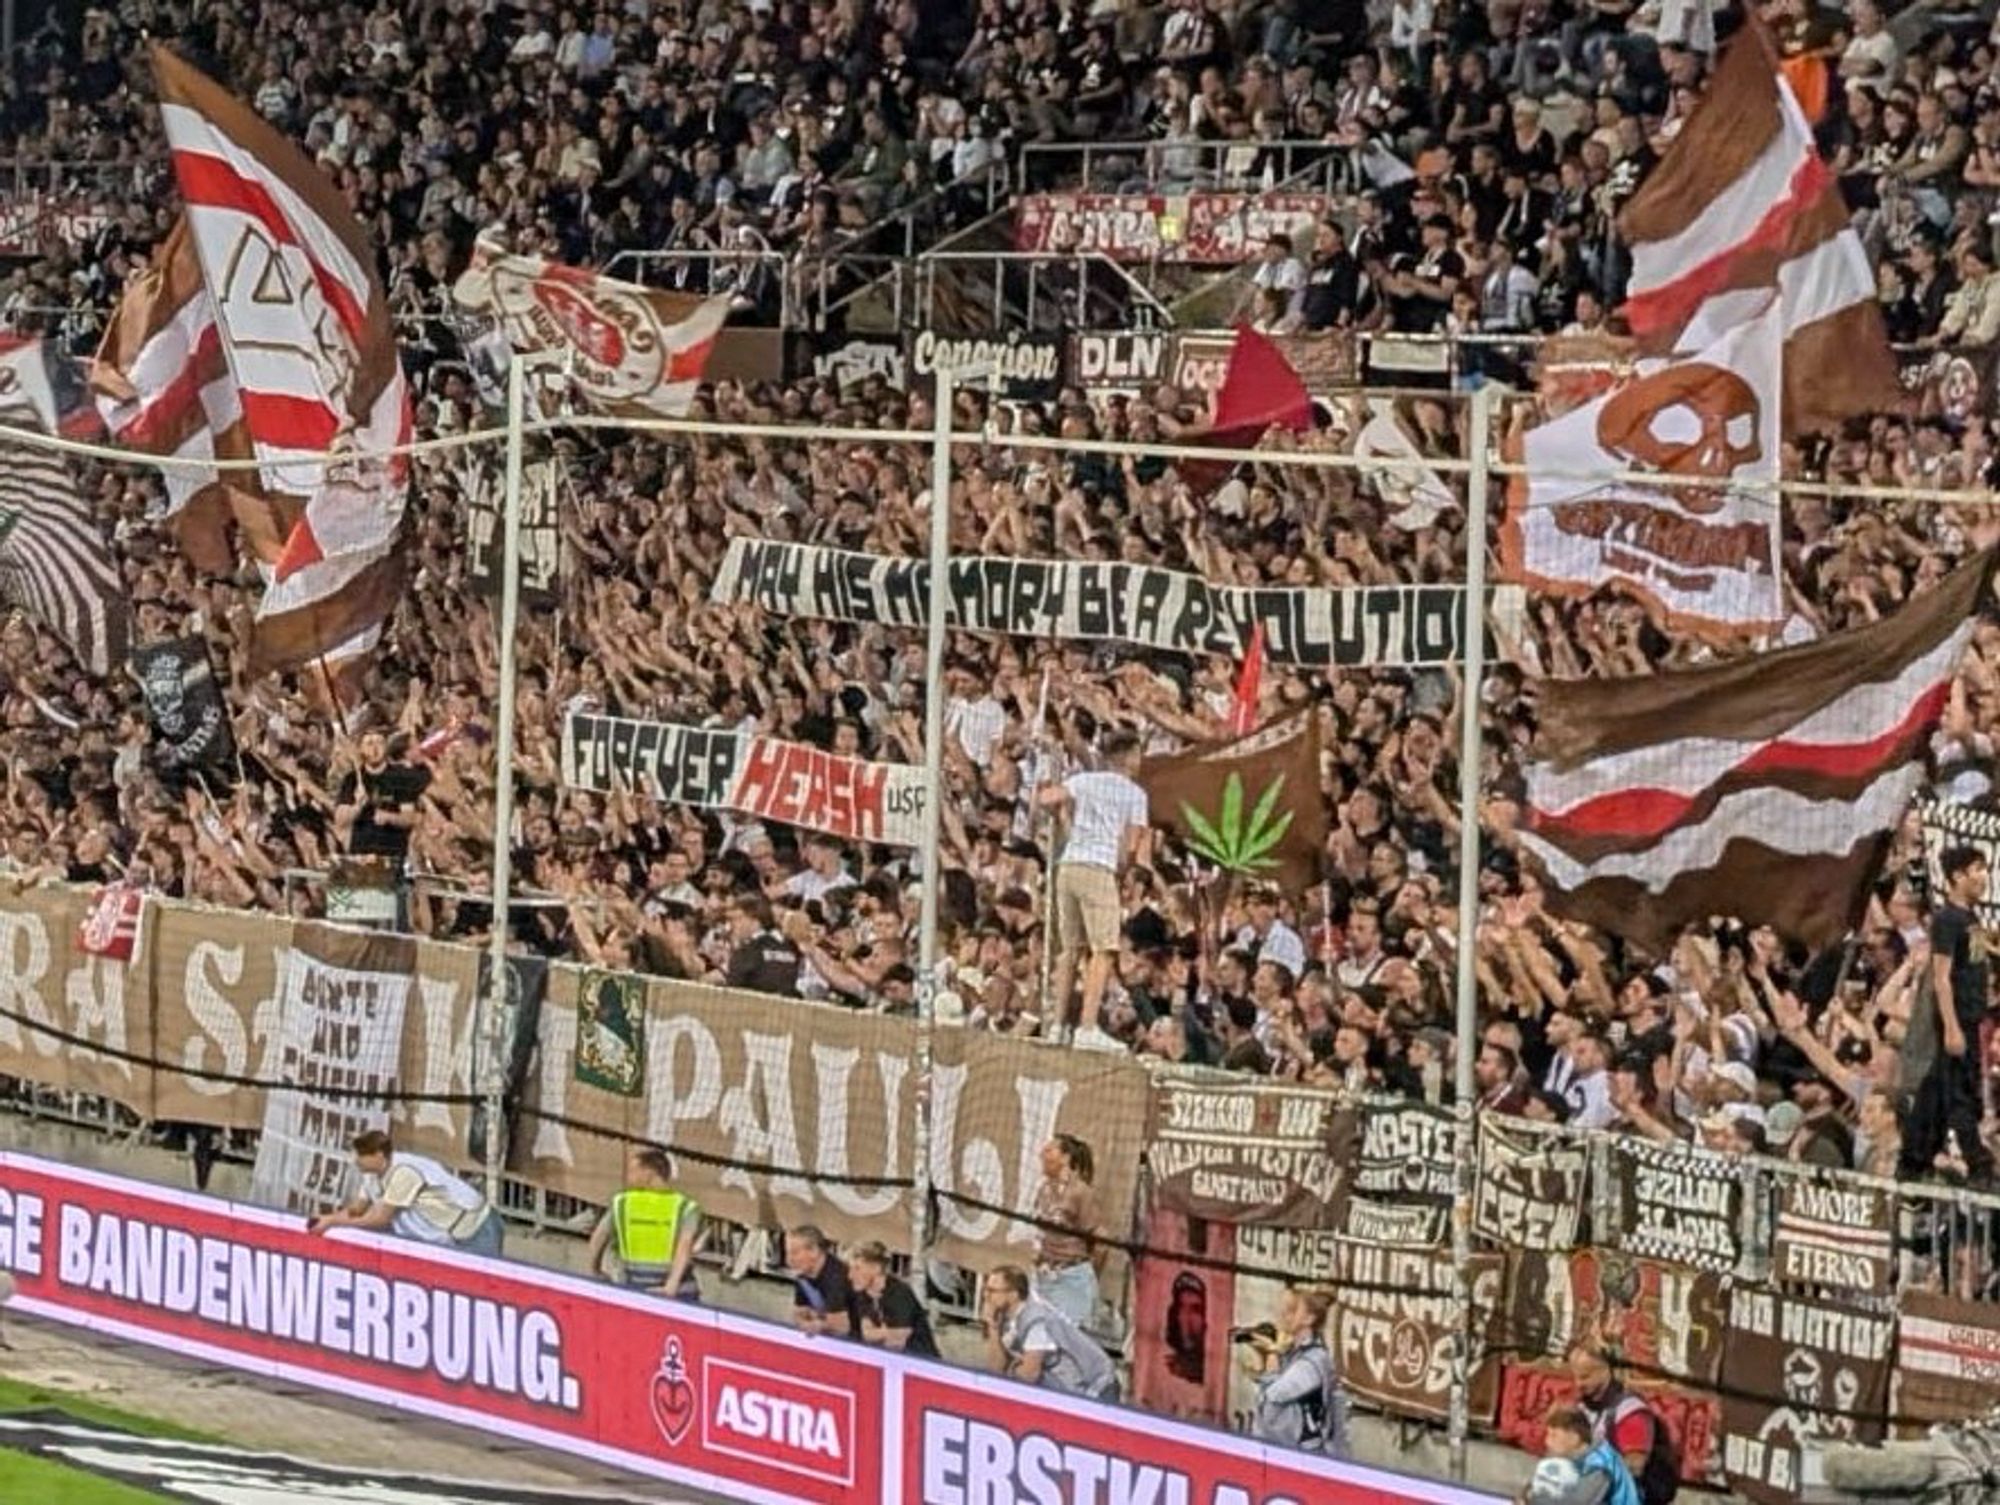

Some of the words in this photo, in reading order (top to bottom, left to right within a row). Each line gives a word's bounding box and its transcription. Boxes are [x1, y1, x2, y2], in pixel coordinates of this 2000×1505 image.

[1081, 338, 1160, 377] DLN
[739, 542, 802, 615] MAY
[812, 549, 878, 623] HIS
[1079, 564, 1132, 636] BE
[1135, 567, 1169, 642] A
[1792, 1182, 1874, 1227] AMORE
[1786, 1243, 1875, 1291] ETERNO
[59, 1207, 580, 1409] BANDENWERBUNG.
[716, 1384, 843, 1459] ASTRA
